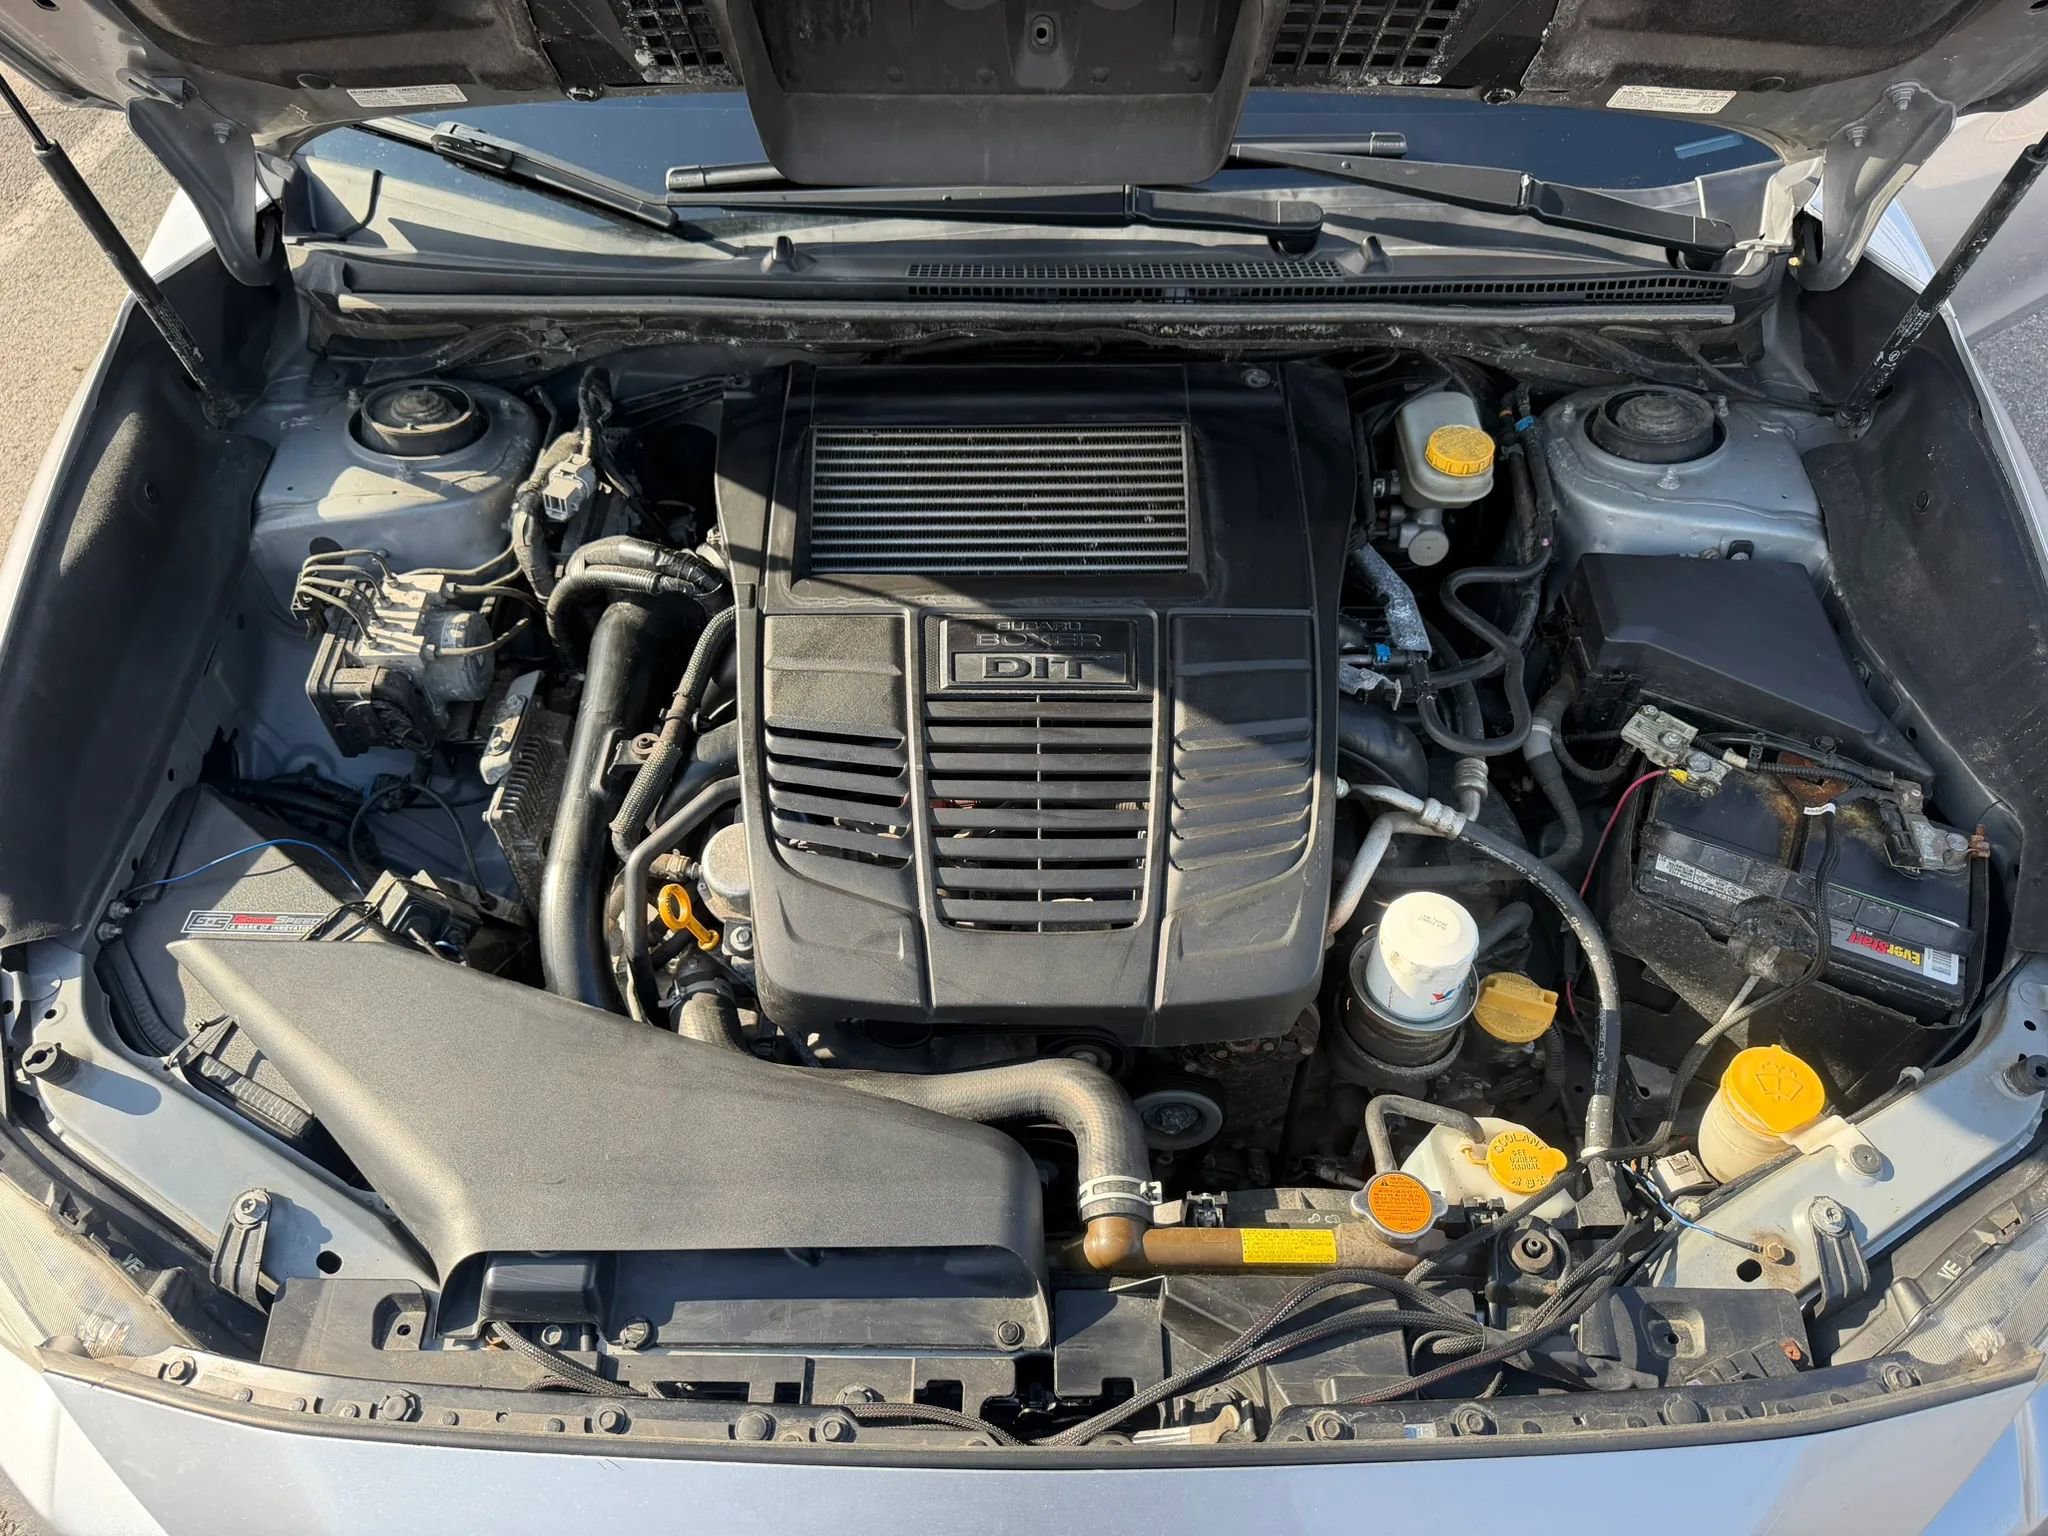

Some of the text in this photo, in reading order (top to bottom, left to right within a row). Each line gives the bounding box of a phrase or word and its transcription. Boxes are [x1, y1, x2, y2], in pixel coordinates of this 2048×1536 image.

[996, 621, 1082, 632] SUBARU
[975, 633, 1102, 647] BOXER
[984, 656, 1098, 679] DIT
[1680, 879, 1741, 905] NGER/POISON
[1856, 926, 1873, 935] PLUS
[1589, 1122, 1596, 1137] DL
[1493, 1133, 1548, 1153] COOLANT
[1511, 1149, 1526, 1157] SEE
[1937, 1260, 1962, 1280] VE
